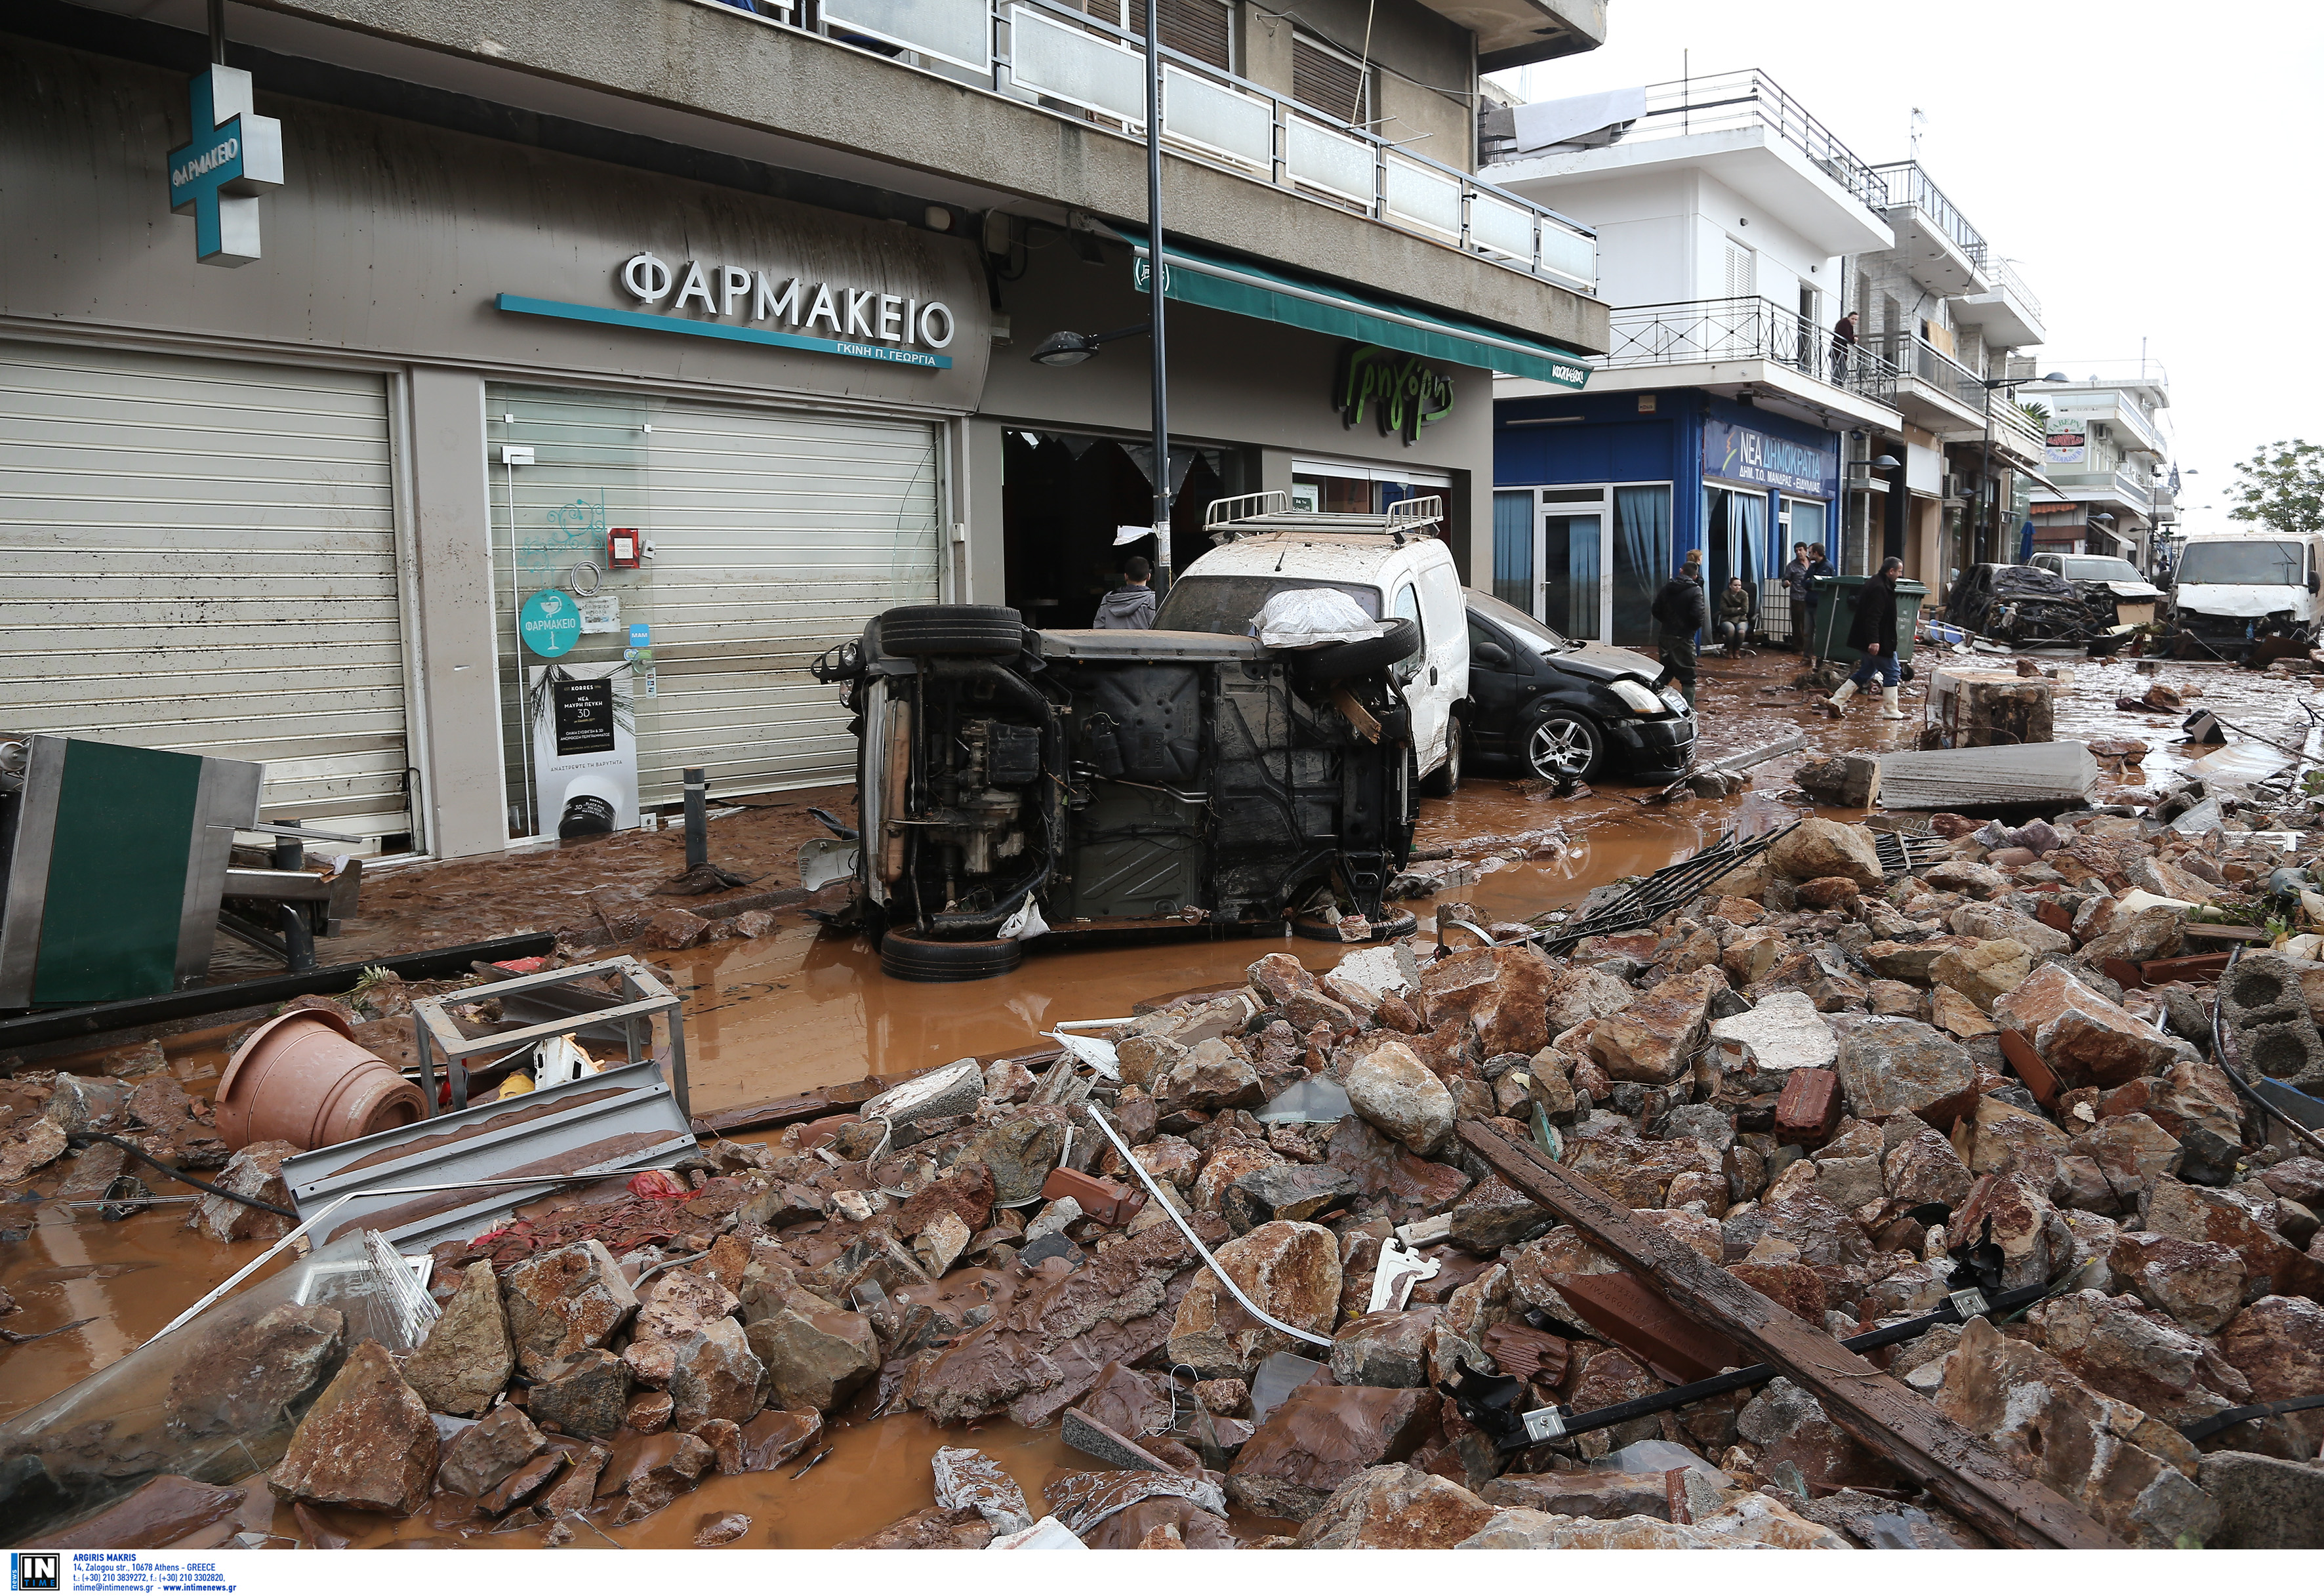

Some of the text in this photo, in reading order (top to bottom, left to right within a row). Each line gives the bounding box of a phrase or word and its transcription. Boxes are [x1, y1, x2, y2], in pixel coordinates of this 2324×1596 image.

[173, 138, 237, 187] ΦΑΡΜΑΚΕΙΟ
[620, 251, 954, 348] ΦΑΡΜΑΚΕΙΟ
[837, 342, 936, 365] ΓΚΙΝΗ Π. ΓΕΩΡΓΙΑ
[1345, 343, 1454, 441] Γρηγόρης
[1740, 431, 1820, 480] ΝΕΑ ΔΗΜΟΚΡΑΤΙΑ
[1739, 464, 1755, 479] ΔΗΜ.
[1755, 468, 1766, 481] Τ.Ο.
[1767, 470, 1792, 487] ΜΑΝΔΡΑΣ
[525, 618, 576, 631] ΦΑΡΜΑΚΕΙΟ
[577, 708, 590, 718] 3D
